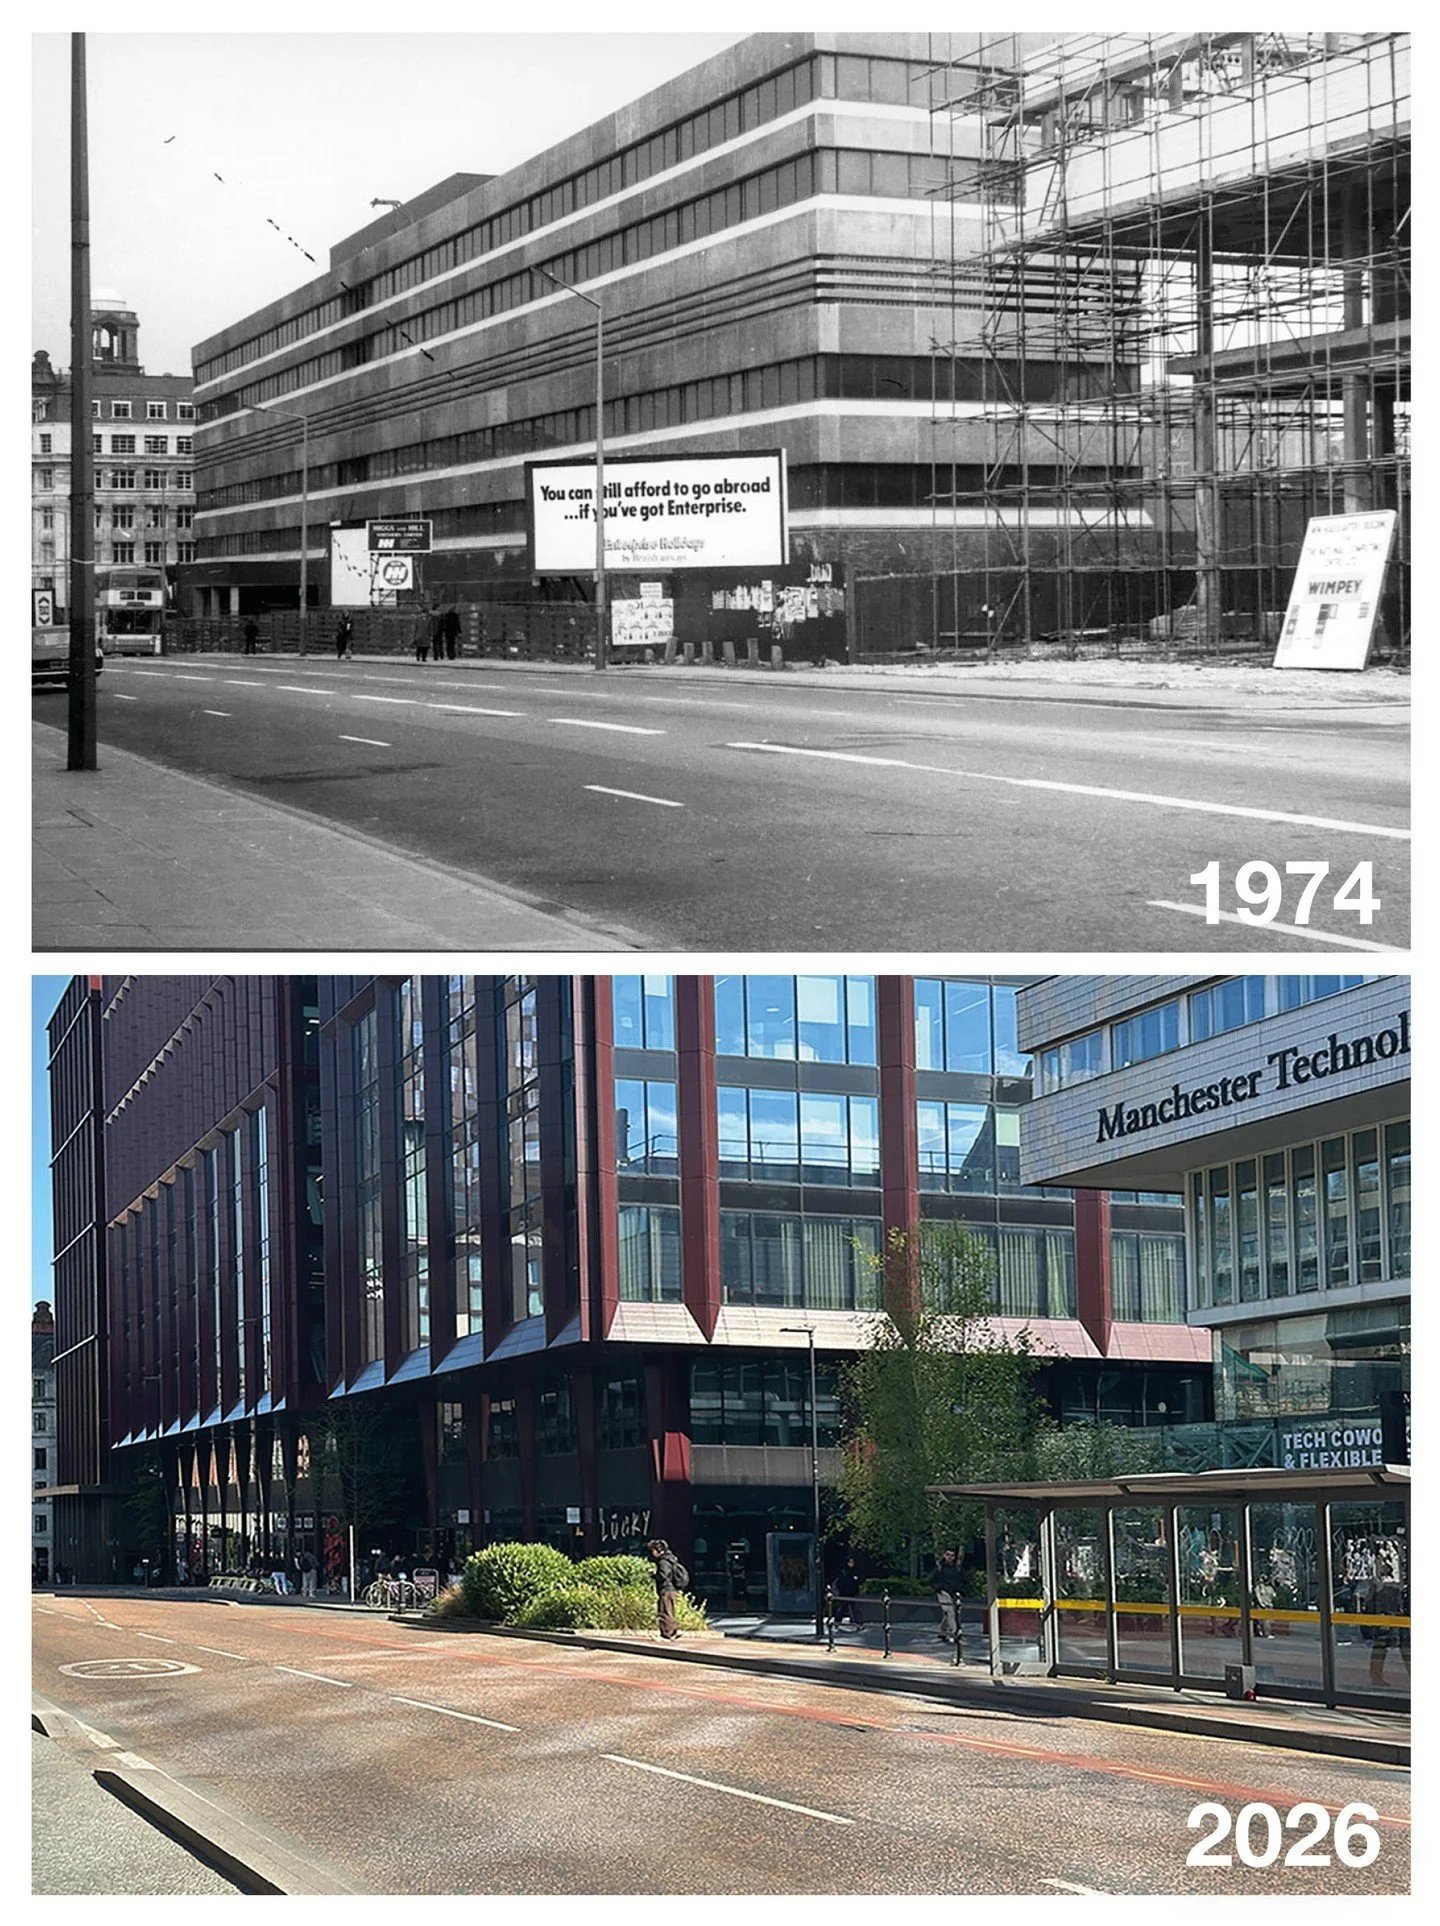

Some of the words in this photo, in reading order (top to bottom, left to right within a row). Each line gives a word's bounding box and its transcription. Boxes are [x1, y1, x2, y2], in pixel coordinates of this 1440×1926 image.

[540, 485, 565, 501] You
[568, 486, 593, 501] can
[625, 479, 671, 498] afford
[674, 482, 689, 497] to
[692, 483, 711, 500] go
[714, 476, 771, 495] abroad
[640, 501, 665, 521] got
[668, 499, 747, 518] Enterprise.
[1308, 579, 1363, 596] WIMPEY
[1096, 1070, 1262, 1143] Manchester
[1267, 1011, 1411, 1090] Technol
[1282, 1431, 1326, 1449] TECH
[1284, 1453, 1296, 1469] &
[1300, 1448, 1383, 1469] FLEXIBLE
